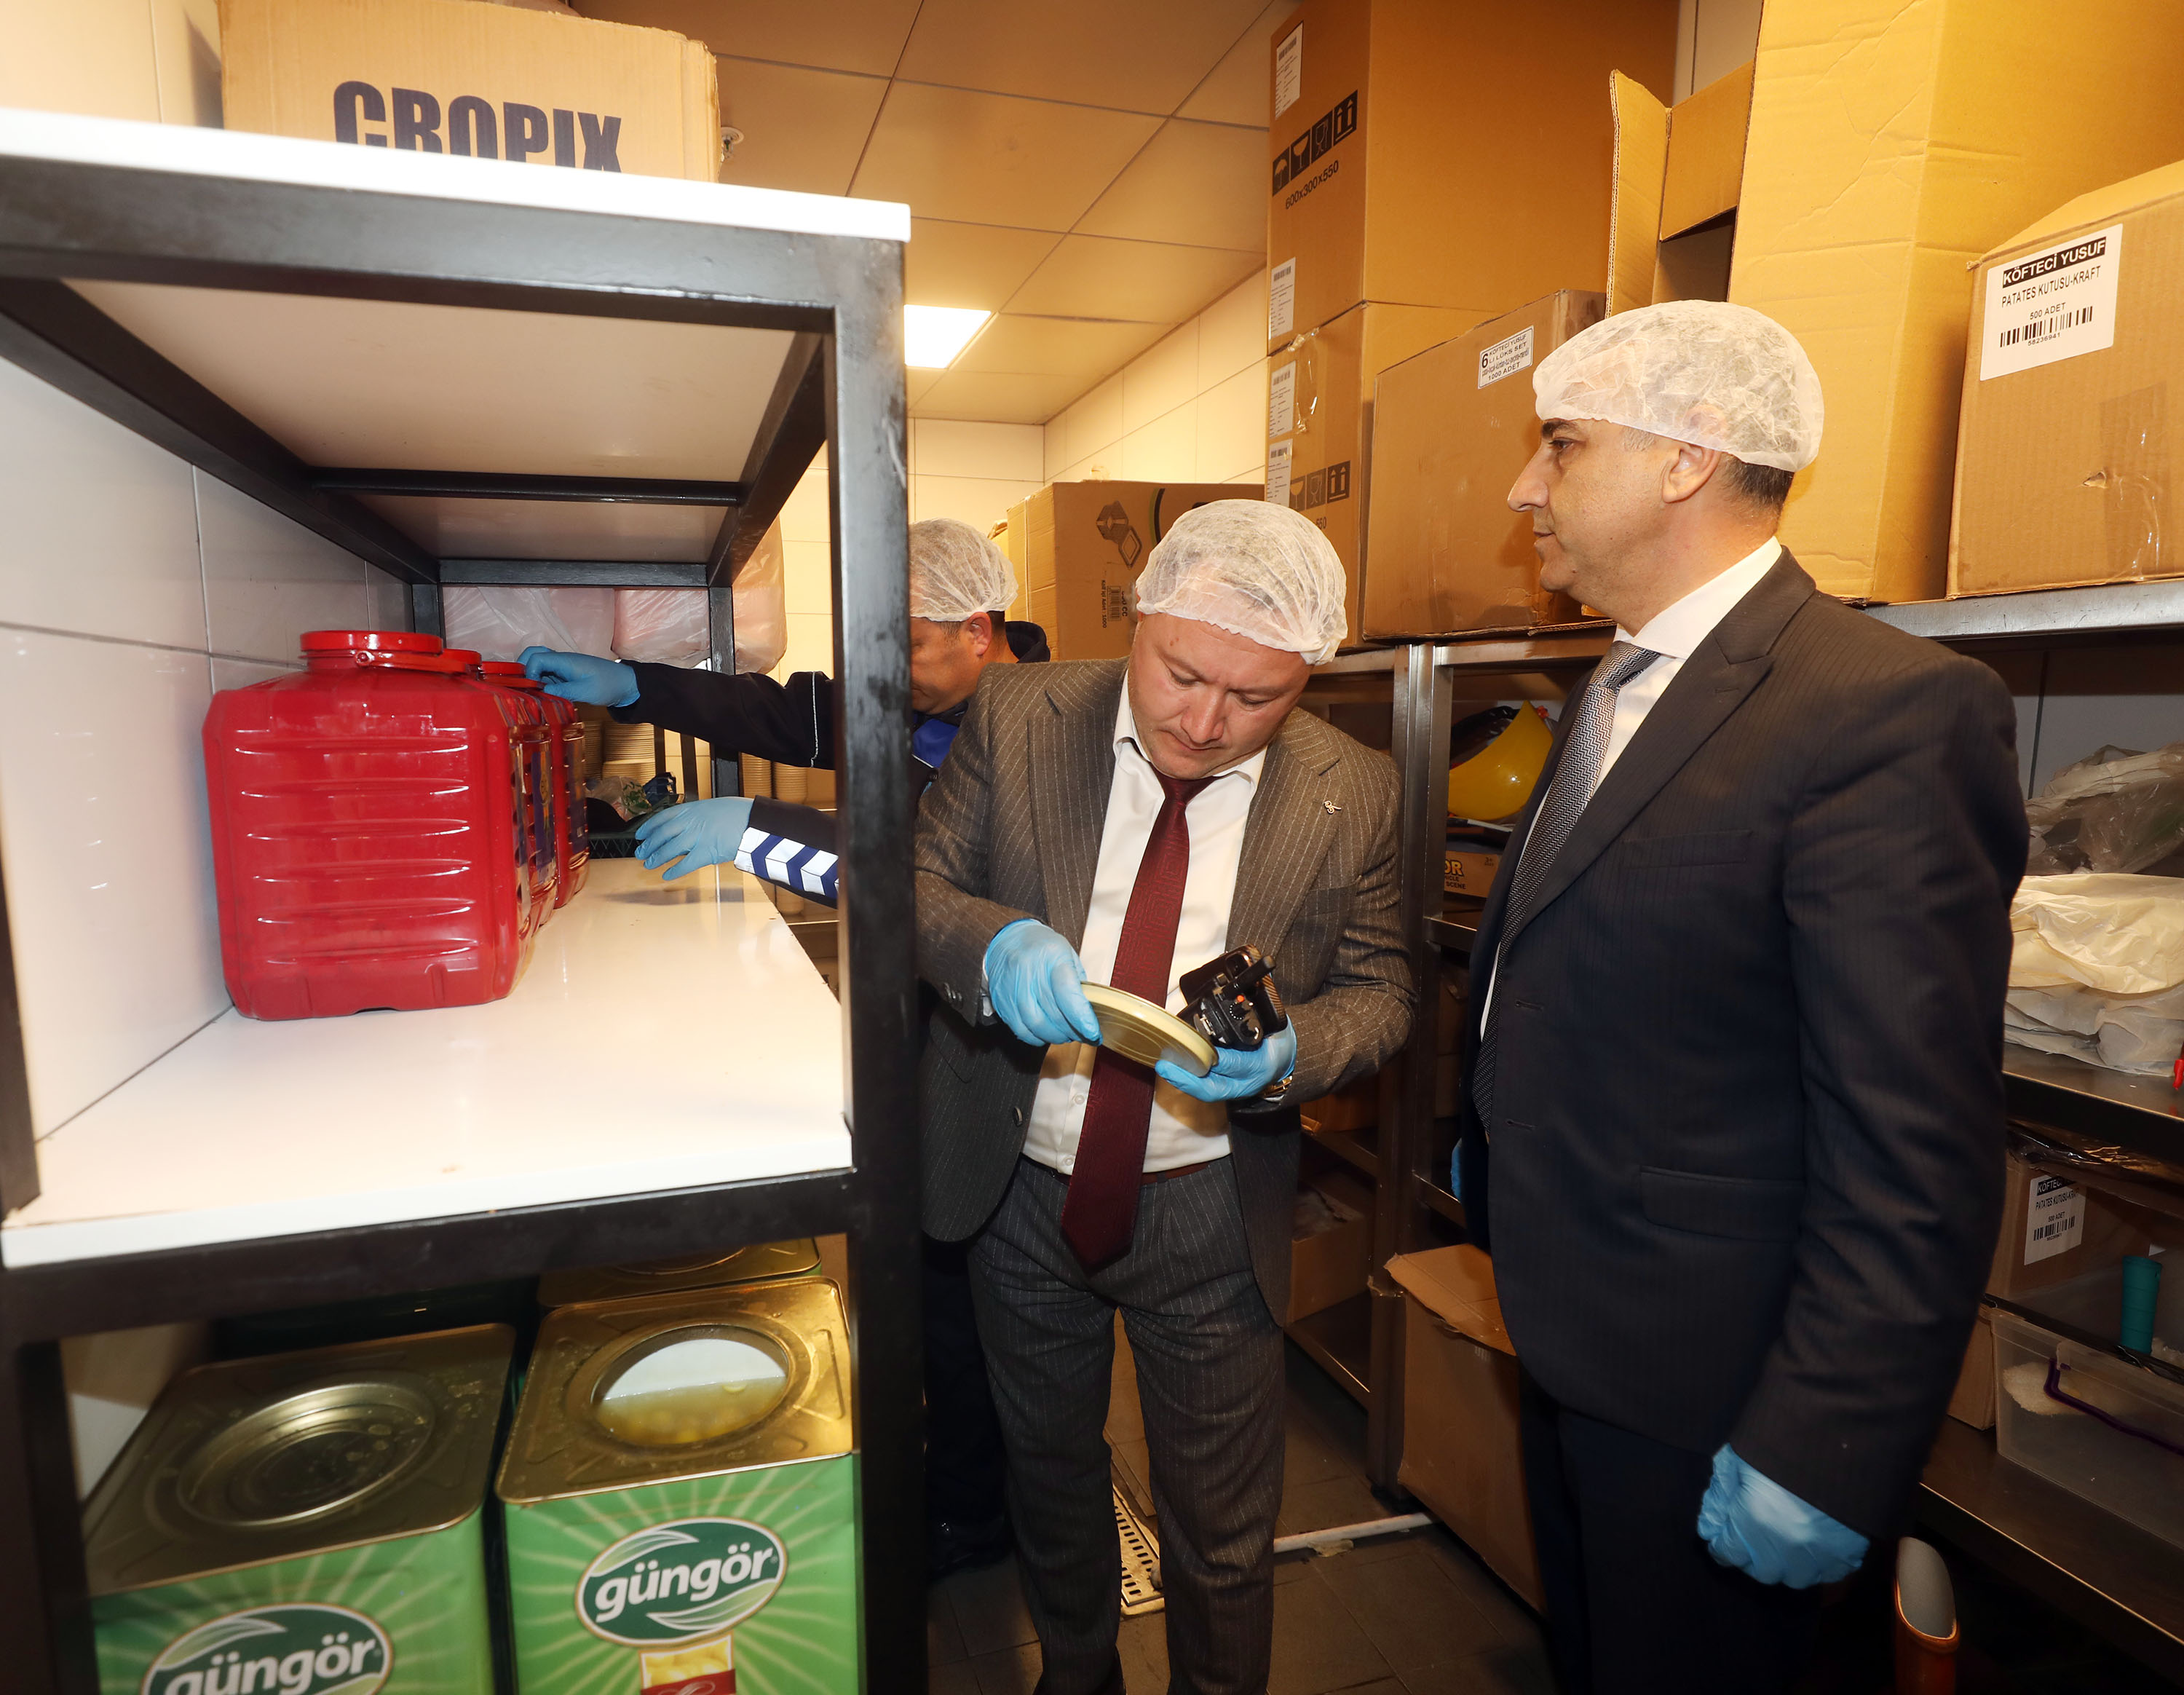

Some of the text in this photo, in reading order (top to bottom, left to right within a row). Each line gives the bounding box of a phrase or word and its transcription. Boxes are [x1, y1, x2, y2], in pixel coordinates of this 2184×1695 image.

[1286, 160, 1339, 210] 600x300x550
[2003, 240, 2105, 285] KÖFTECİ YUSUF
[2002, 266, 2101, 307] PATATES KUTUSU-KRAFT
[2030, 302, 2066, 320] 500 ADET
[1511, 333, 1527, 346] YUSUF
[1514, 341, 1527, 351] SET
[2027, 332, 2060, 346] 58236941
[1482, 353, 1488, 368] 6
[1488, 362, 1520, 381] 1000 ADET
[1447, 882, 1466, 890] SCENE
[2038, 1179, 2062, 1192] KÖFTEC
[2035, 1197, 2053, 1210] PATATES
[2056, 1211, 2065, 1220] ADET
[595, 1541, 774, 1623] güngör
